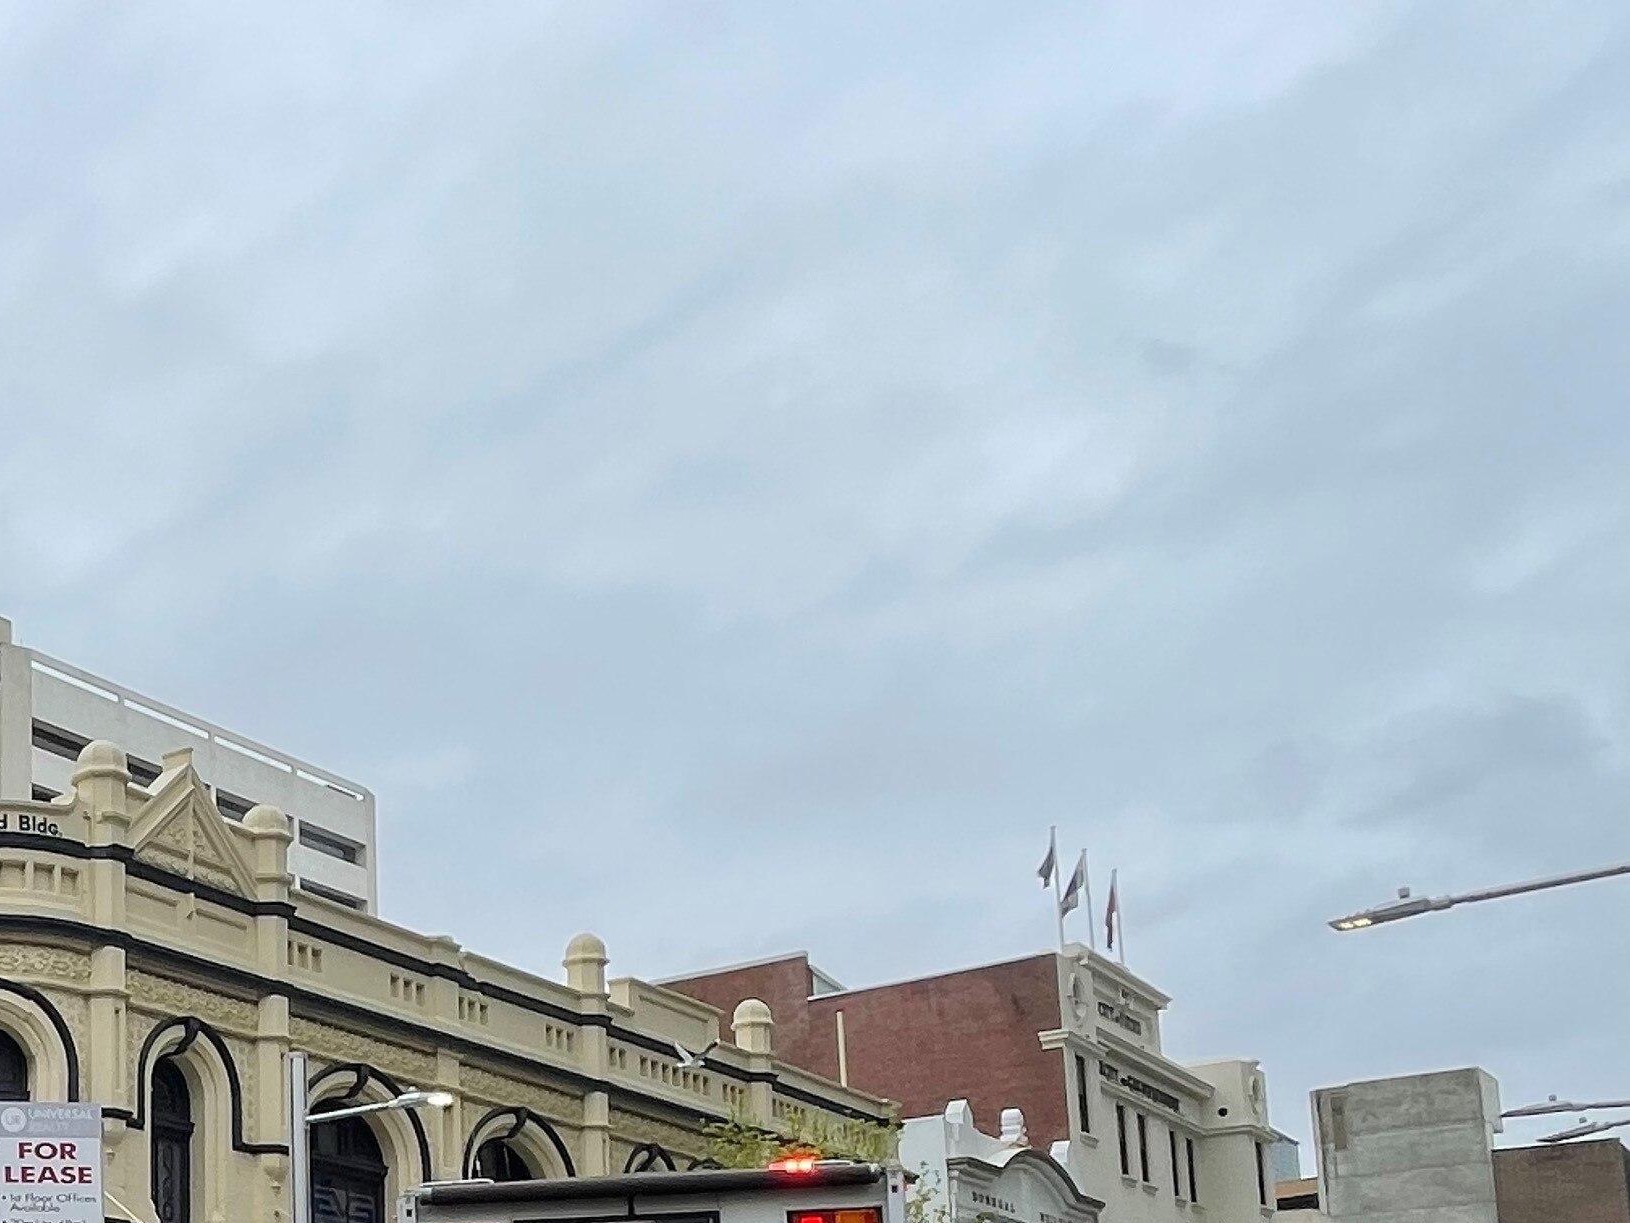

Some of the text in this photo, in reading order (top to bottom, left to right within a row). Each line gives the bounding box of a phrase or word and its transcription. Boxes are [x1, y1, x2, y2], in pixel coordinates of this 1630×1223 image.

[18, 1142, 77, 1160] FOR
[4, 1166, 93, 1184] LEASE
[25, 1193, 53, 1203] Floor
[56, 1193, 97, 1204] Offices
[10, 1203, 61, 1212] Available
